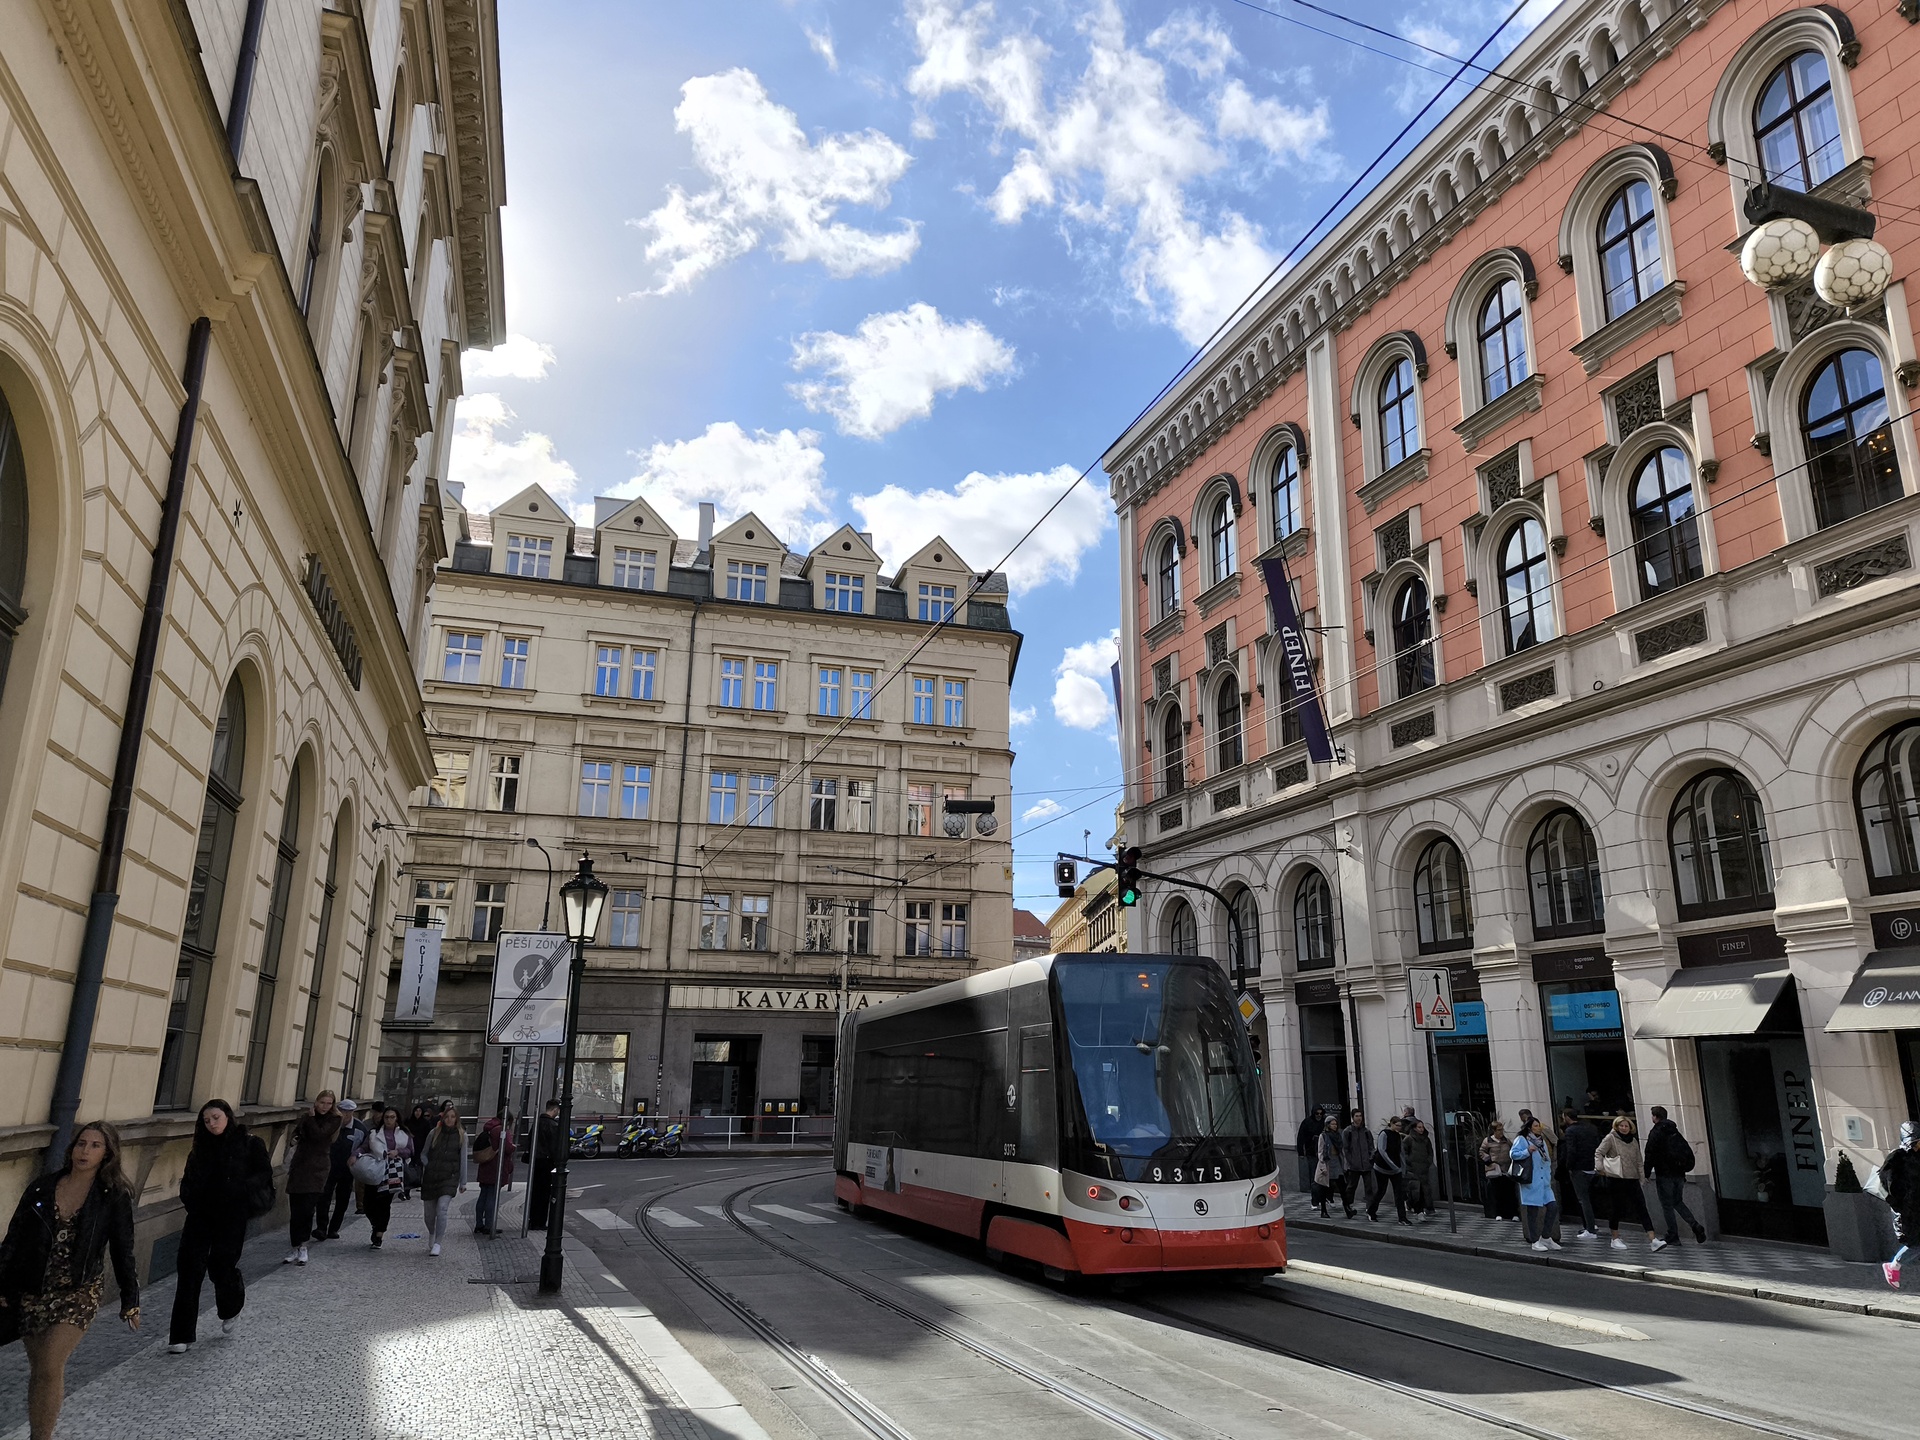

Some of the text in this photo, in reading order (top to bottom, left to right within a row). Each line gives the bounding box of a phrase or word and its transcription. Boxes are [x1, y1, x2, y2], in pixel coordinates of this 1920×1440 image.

[1282, 626, 1311, 692] FINEP
[505, 937, 563, 949] PĚŠÍ ZÓN
[1721, 941, 1746, 951] FINEP
[411, 945, 426, 1016] CITY INN
[1691, 988, 1743, 1002] FINEP
[1583, 1001, 1611, 1010] espresso
[1783, 1070, 1819, 1173] FINEP
[1003, 1142, 1016, 1157] 9375
[1153, 1166, 1222, 1182] 9375
